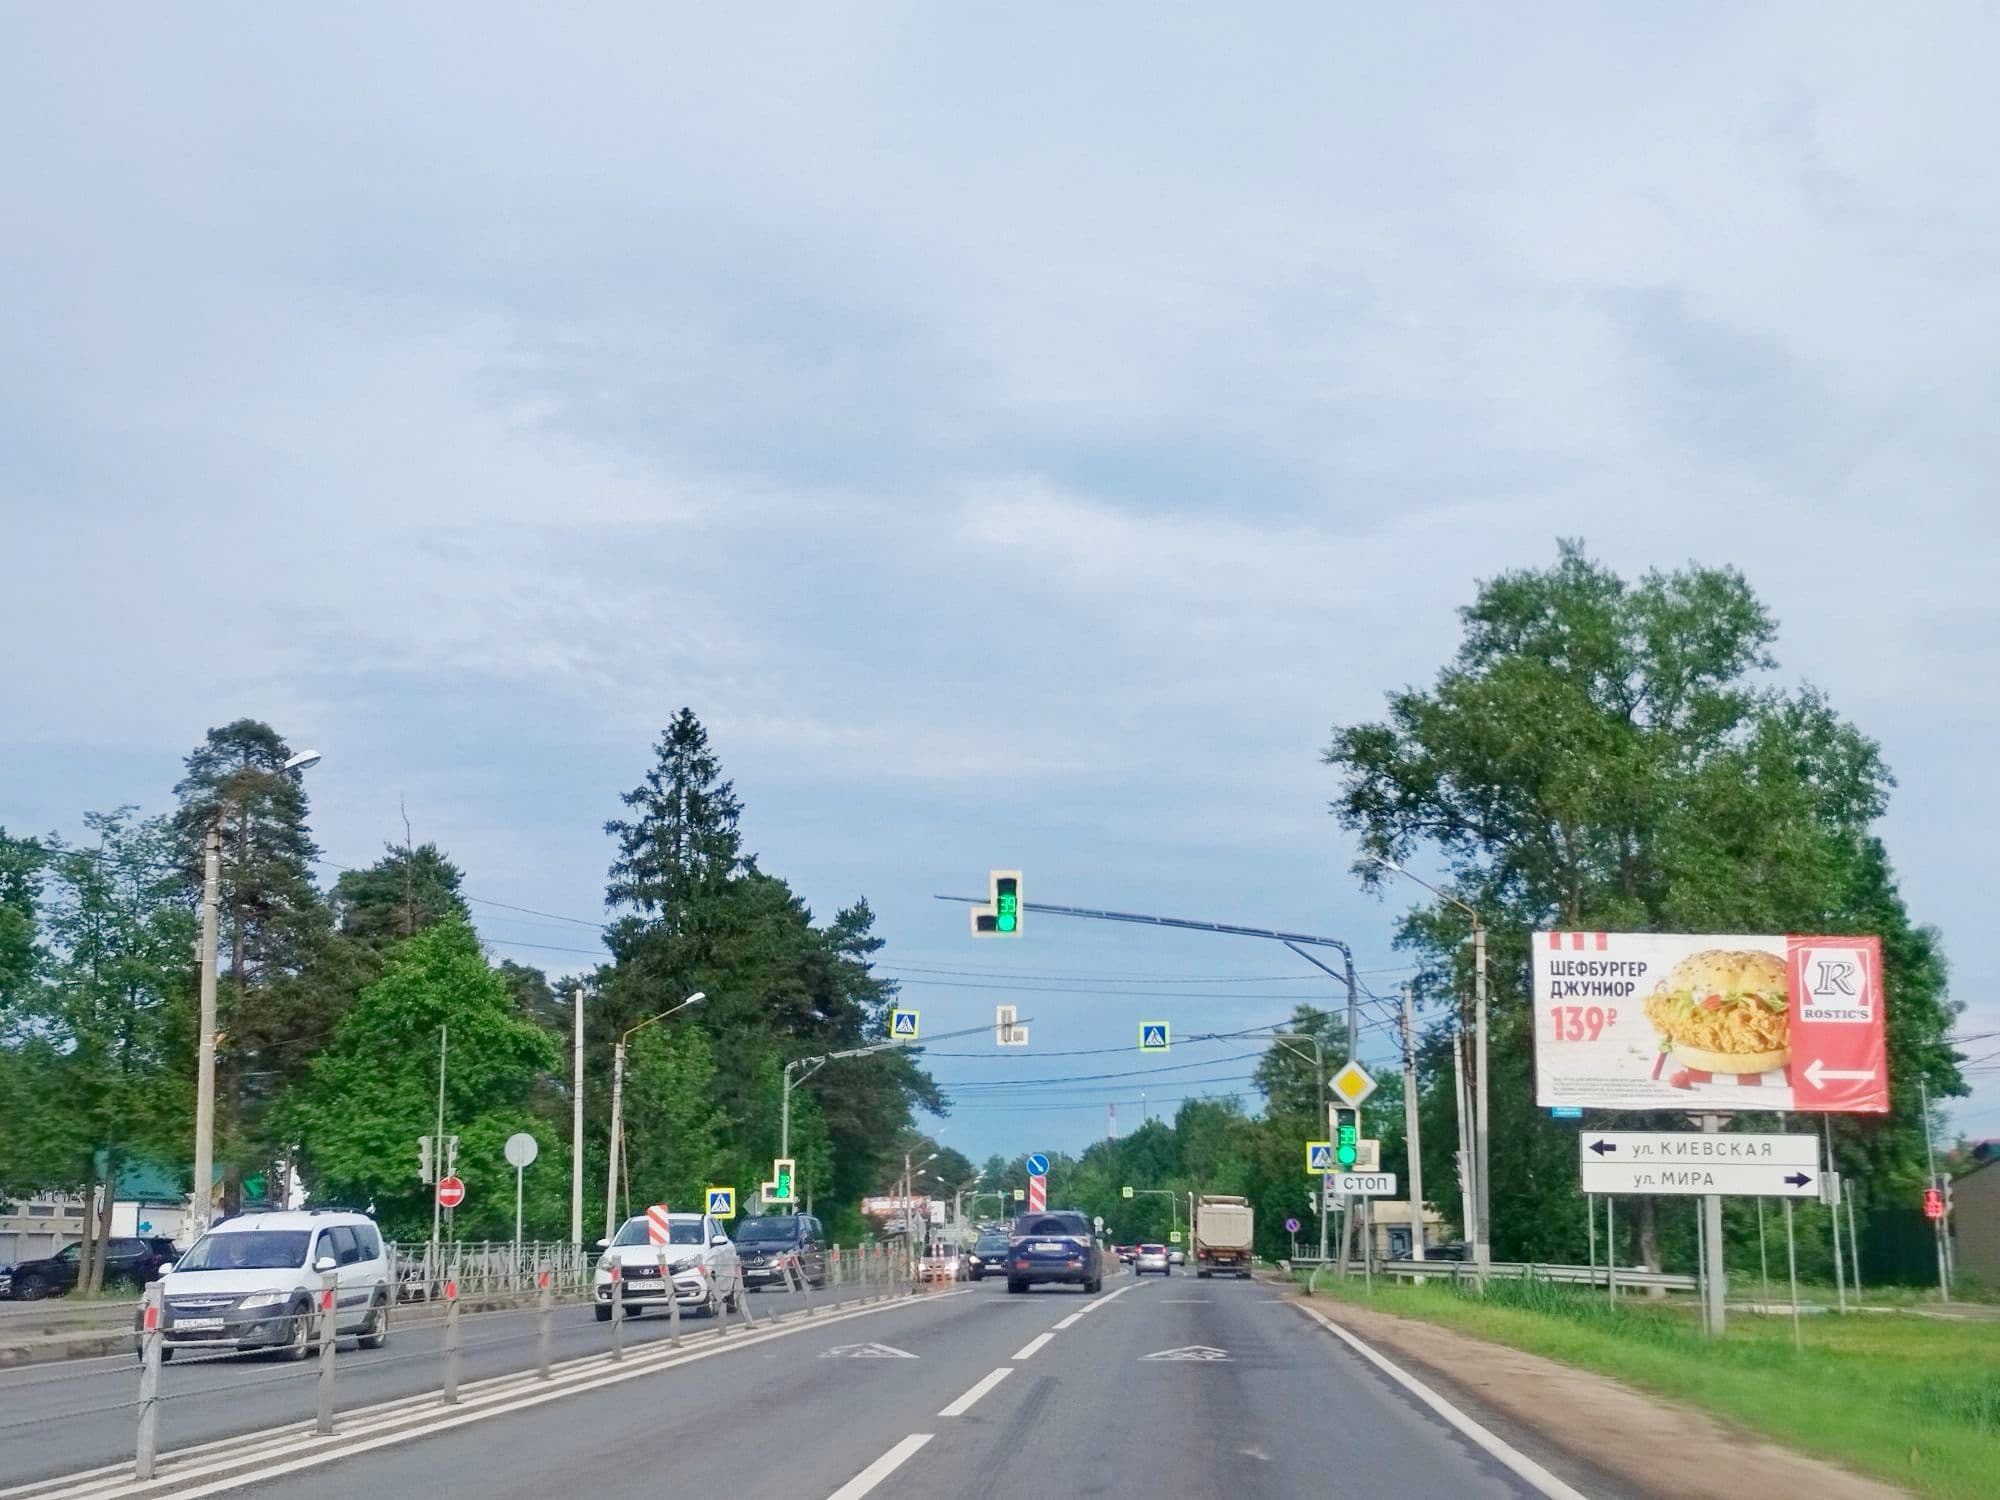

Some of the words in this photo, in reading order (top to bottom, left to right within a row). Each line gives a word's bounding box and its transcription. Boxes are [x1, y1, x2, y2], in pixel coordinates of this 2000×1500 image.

[1550, 960, 1647, 977] ШЕФБУРГЕР
[1550, 980, 1635, 999] ДЖУНИОР
[1804, 1009, 1869, 1020] ROSTIC'S
[1632, 1144, 1654, 1158] ул.
[1660, 1141, 1772, 1156] КИЕВСКАЯ
[1343, 1177, 1387, 1190] СТОП
[1634, 1174, 1655, 1188] ул.
[1661, 1171, 1714, 1185] МИРА
